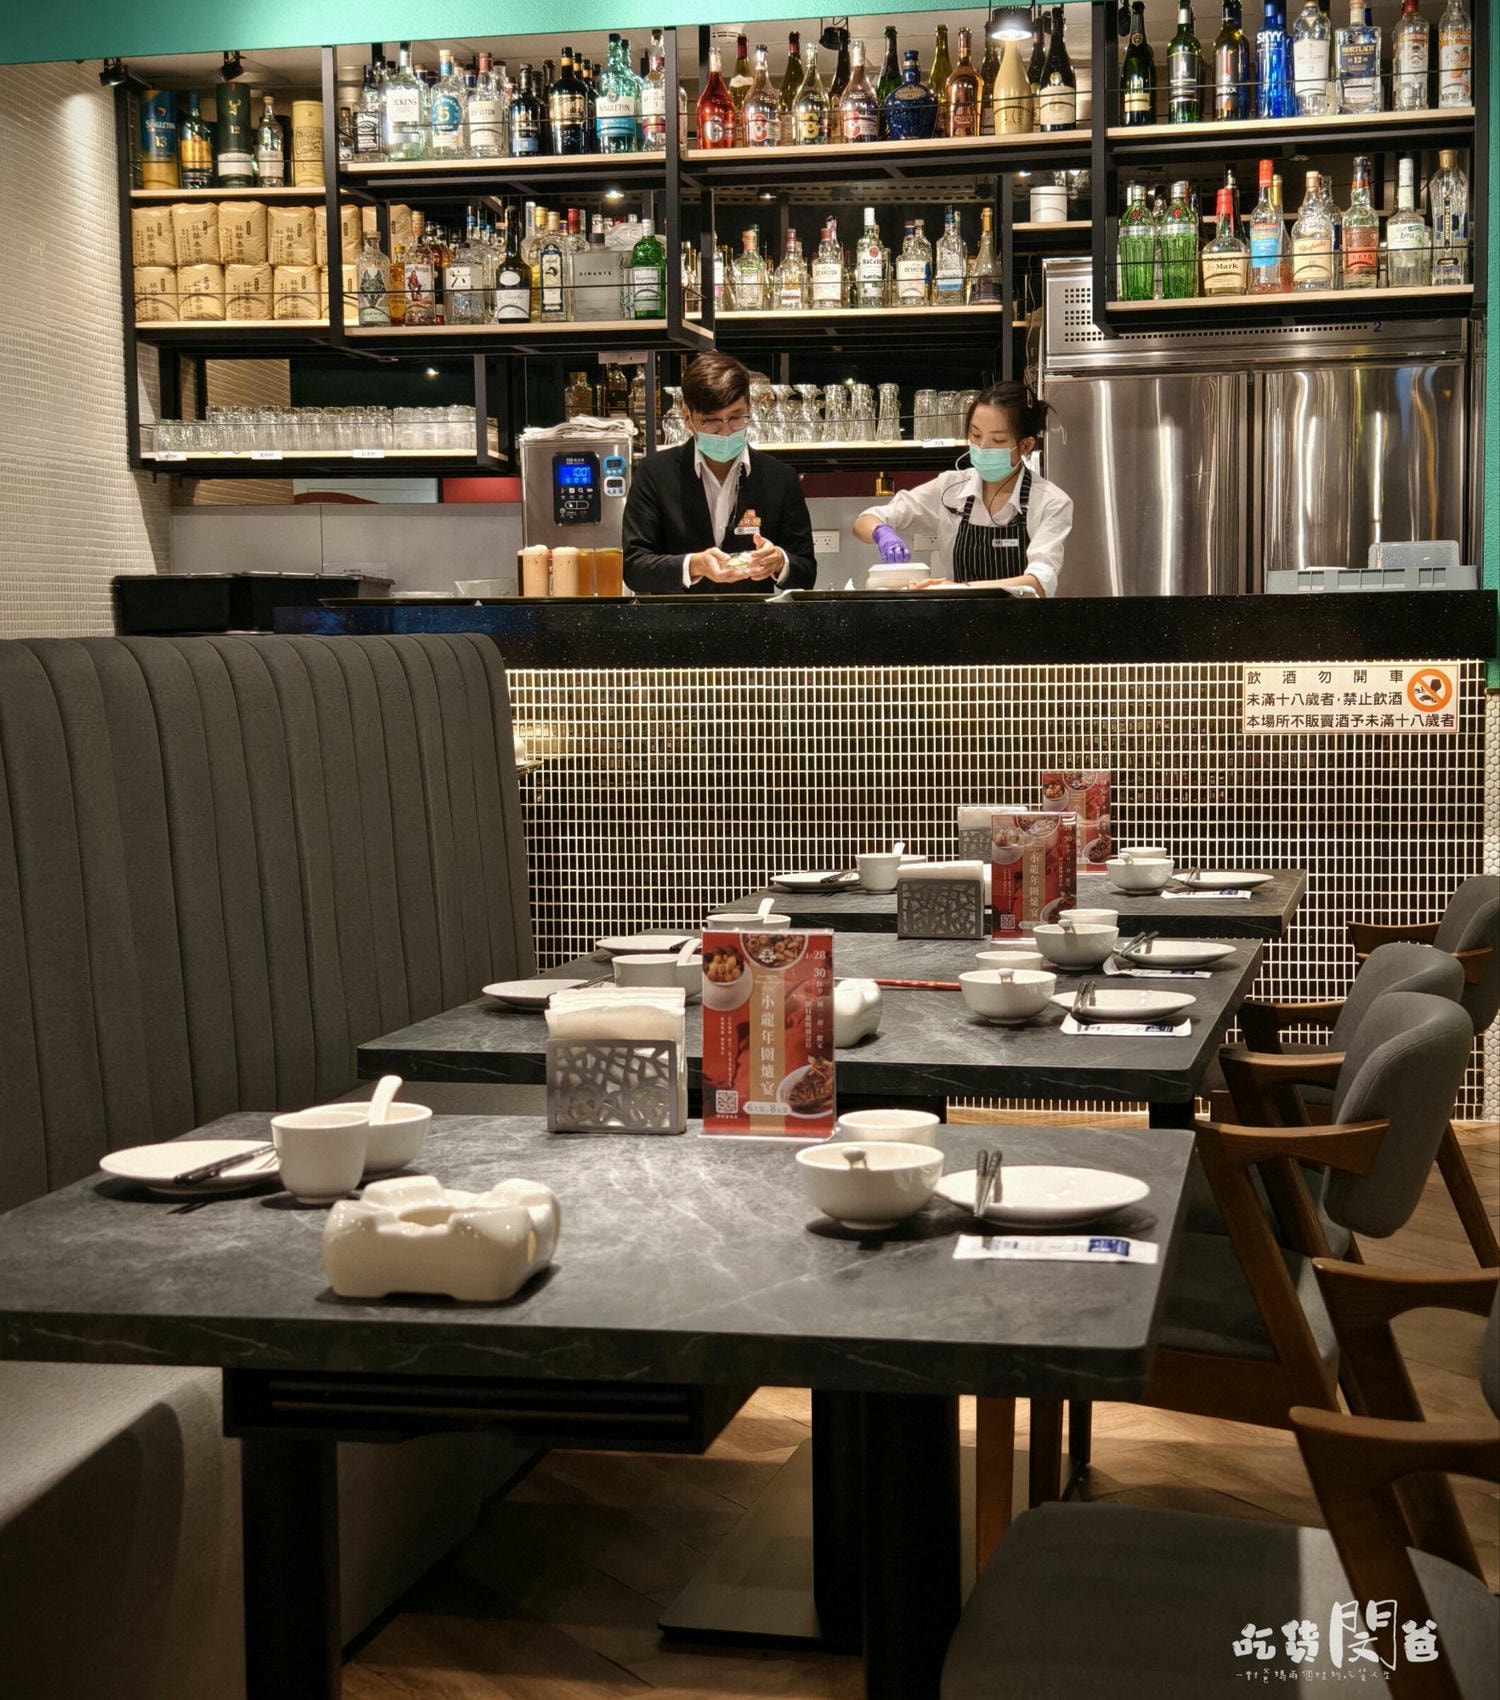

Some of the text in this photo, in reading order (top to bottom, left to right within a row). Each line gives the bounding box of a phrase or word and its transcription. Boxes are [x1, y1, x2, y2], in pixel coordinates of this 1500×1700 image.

[1256, 31, 1283, 44] SKYY
[1341, 45, 1375, 55] MORTLACH
[1215, 262, 1239, 271] Mark
[1247, 670, 1404, 684] 飲酒勿開車
[1246, 714, 1455, 728] 本場所不販賣酒予未滿十八歲者
